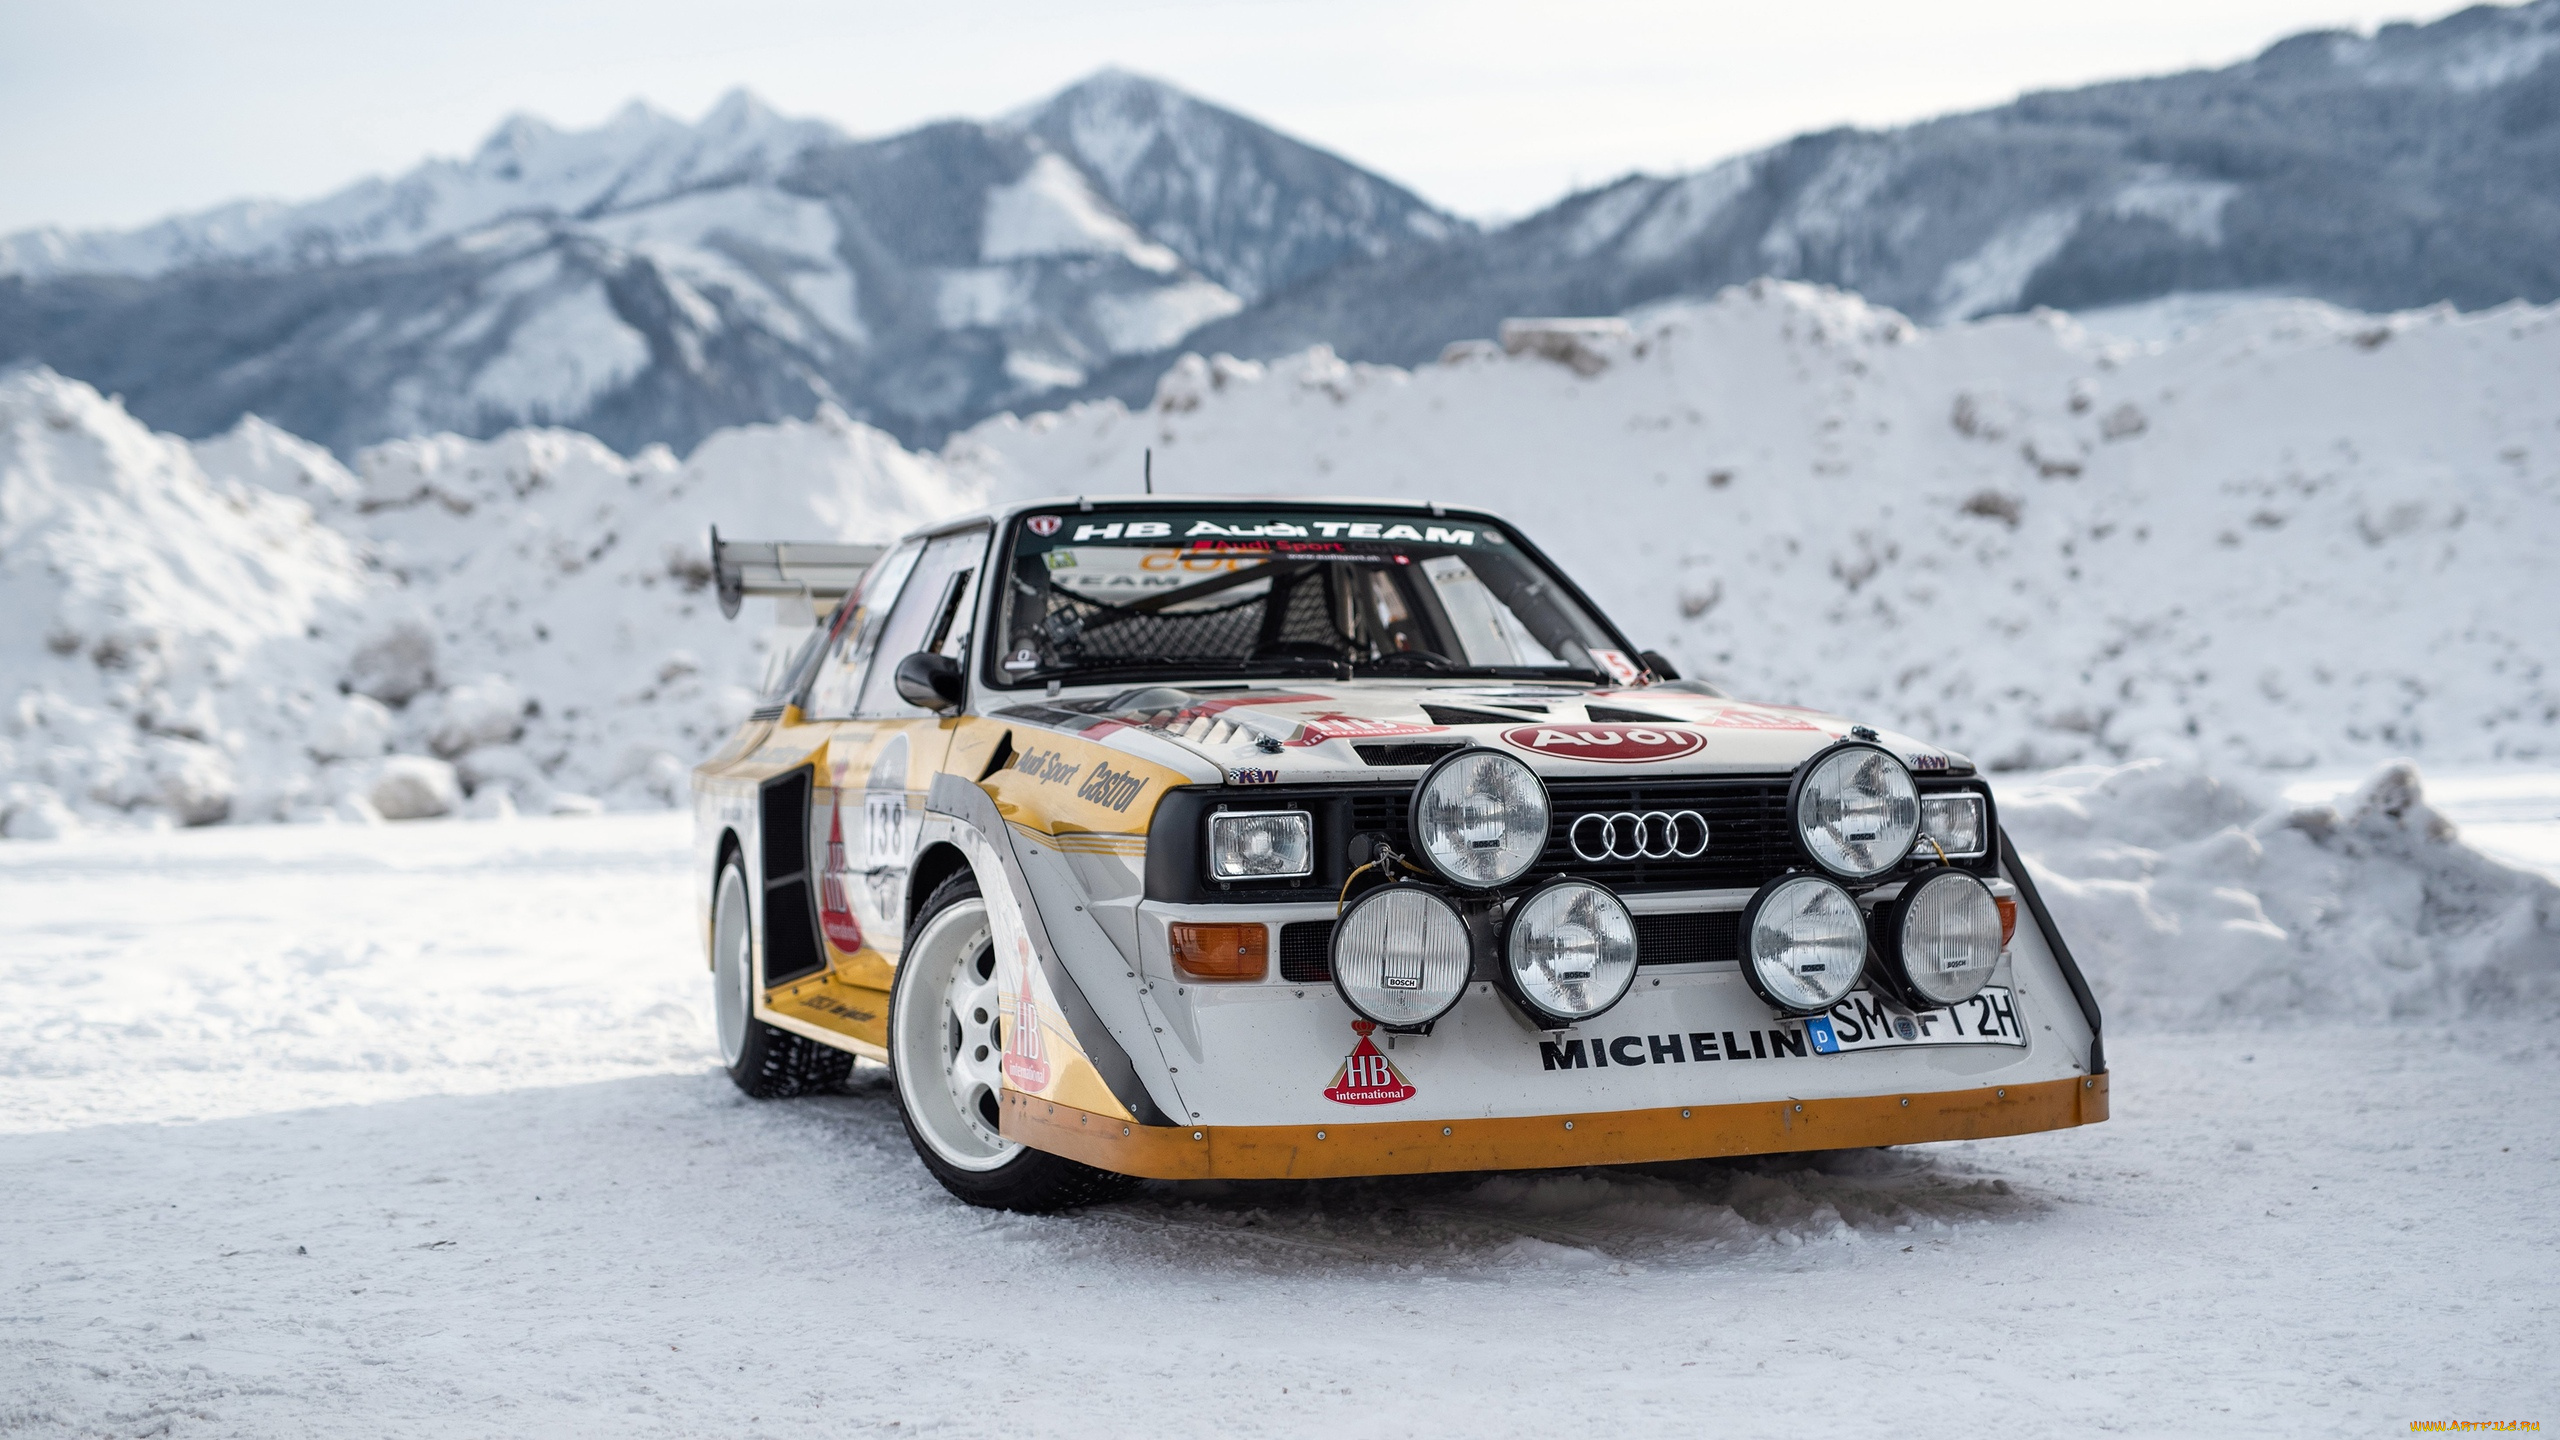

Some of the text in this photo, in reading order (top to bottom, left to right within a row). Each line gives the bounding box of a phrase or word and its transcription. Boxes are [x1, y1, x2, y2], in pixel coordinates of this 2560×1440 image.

[1073, 522, 1172, 541] HB
[1313, 521, 1476, 546] TEAM
[1276, 540, 1346, 553] Sport
[1015, 746, 1150, 813] Audi Sport Castrol
[1238, 770, 1279, 784] KW
[1473, 840, 1499, 848] BOSCH
[1390, 979, 1415, 987] BOSCH
[1016, 1001, 1039, 1060] HB
[1818, 1030, 1828, 1044] D
[1830, 998, 1894, 1043] SM
[1969, 994, 2021, 1037] 2H
[1538, 1029, 1808, 1070] MICHELIN
[1009, 1060, 1045, 1084] international
[1345, 1054, 1391, 1087] HB
[1336, 1089, 1404, 1100] international
